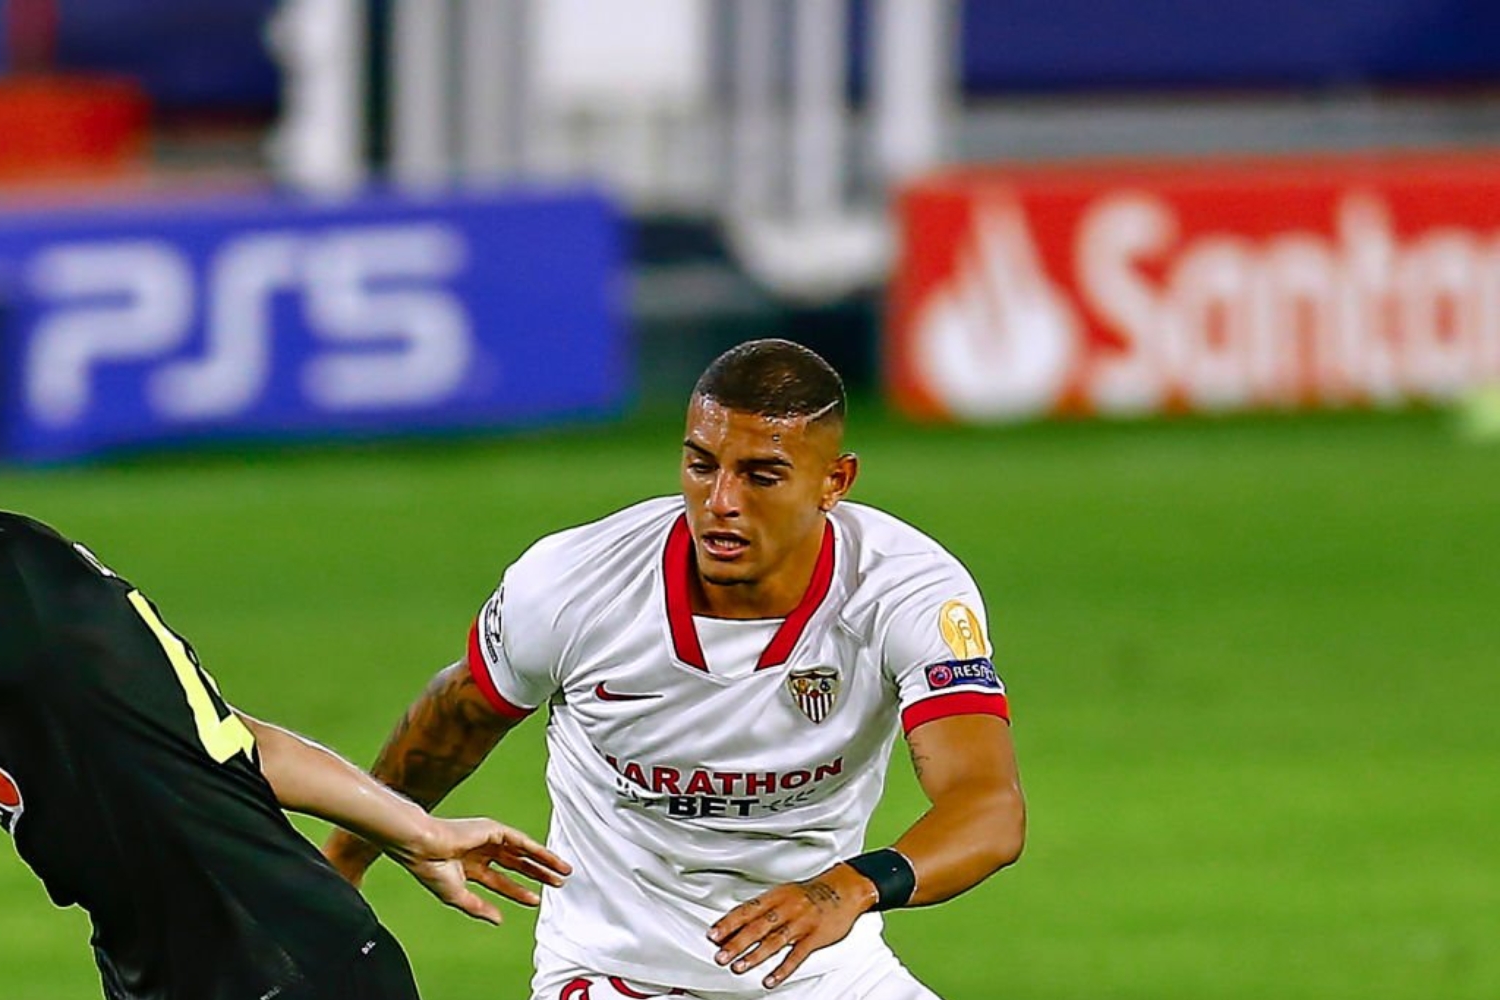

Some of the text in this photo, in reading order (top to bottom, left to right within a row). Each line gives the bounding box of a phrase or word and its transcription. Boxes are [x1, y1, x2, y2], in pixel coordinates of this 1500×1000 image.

[25, 222, 471, 428] PS5
[1072, 190, 1500, 410] Santa
[668, 796, 760, 817] BET
